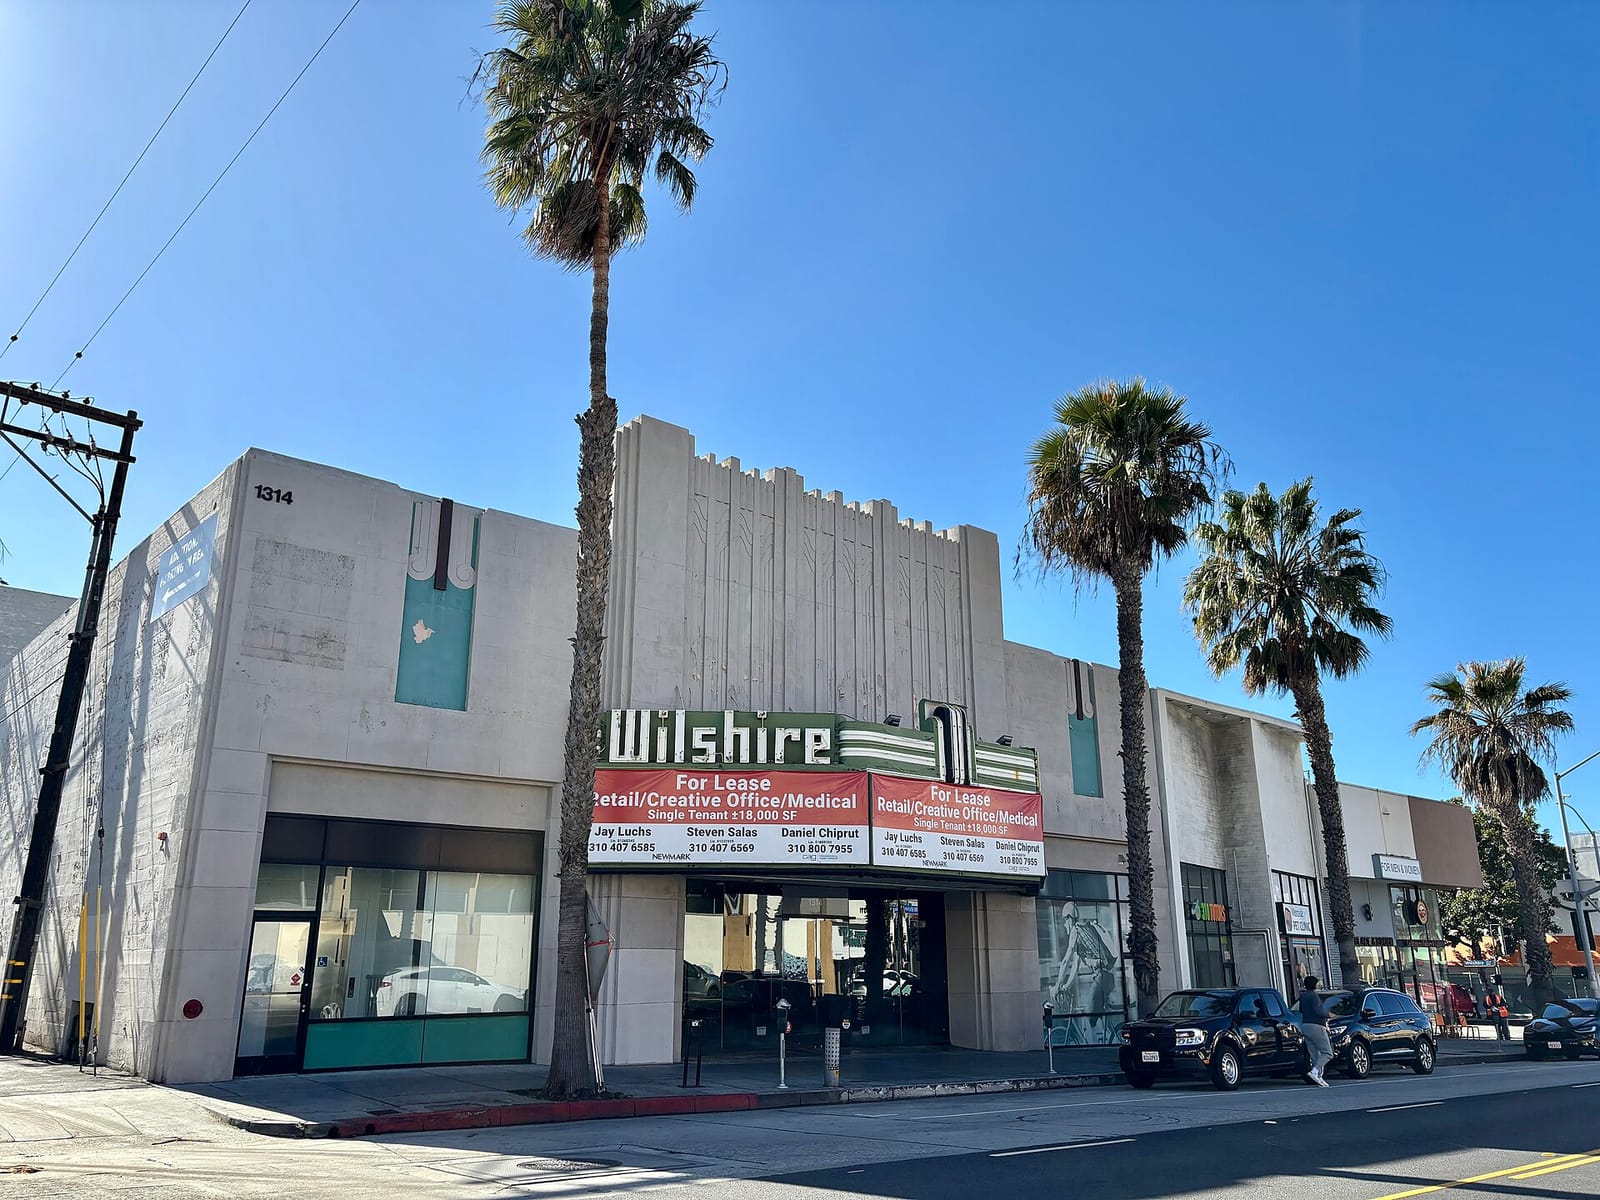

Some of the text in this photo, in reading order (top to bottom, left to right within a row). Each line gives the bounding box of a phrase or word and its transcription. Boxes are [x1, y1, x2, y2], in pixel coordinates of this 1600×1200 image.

[254, 484, 294, 505] 1314
[608, 709, 831, 764] Wilshire
[676, 774, 771, 791] For Lease
[726, 792, 857, 809] Office/Medical
[931, 785, 991, 806] For Lease
[647, 809, 798, 822] Single Tenant ±18,000 SF
[877, 796, 1038, 827] Retail/Creative Office/Medical
[594, 826, 652, 838] Jay Luchs
[687, 827, 758, 837] Steven Salas
[913, 817, 1008, 835] Single Tenant ±18,000 SF
[781, 828, 860, 840] Daniel Chiprut
[884, 831, 923, 843] Jay Luchs
[589, 843, 656, 852] 310 407 6585
[689, 843, 755, 852] 310 407 6569
[787, 844, 853, 853] 310 800 7955
[940, 836, 986, 849] Steven Salas
[996, 841, 1040, 854] Daniel Chiprut
[881, 847, 895, 856] 310
[896, 848, 909, 857] 407
[909, 849, 927, 859] 6585
[943, 851, 955, 861] 310
[956, 853, 968, 862] 407
[969, 854, 985, 863] 6569
[922, 860, 949, 868] NEWMARK
[1000, 855, 1011, 864] 310
[1012, 856, 1023, 865] 800
[1024, 858, 1038, 866] 7955
[1380, 862, 1391, 872] FOR
